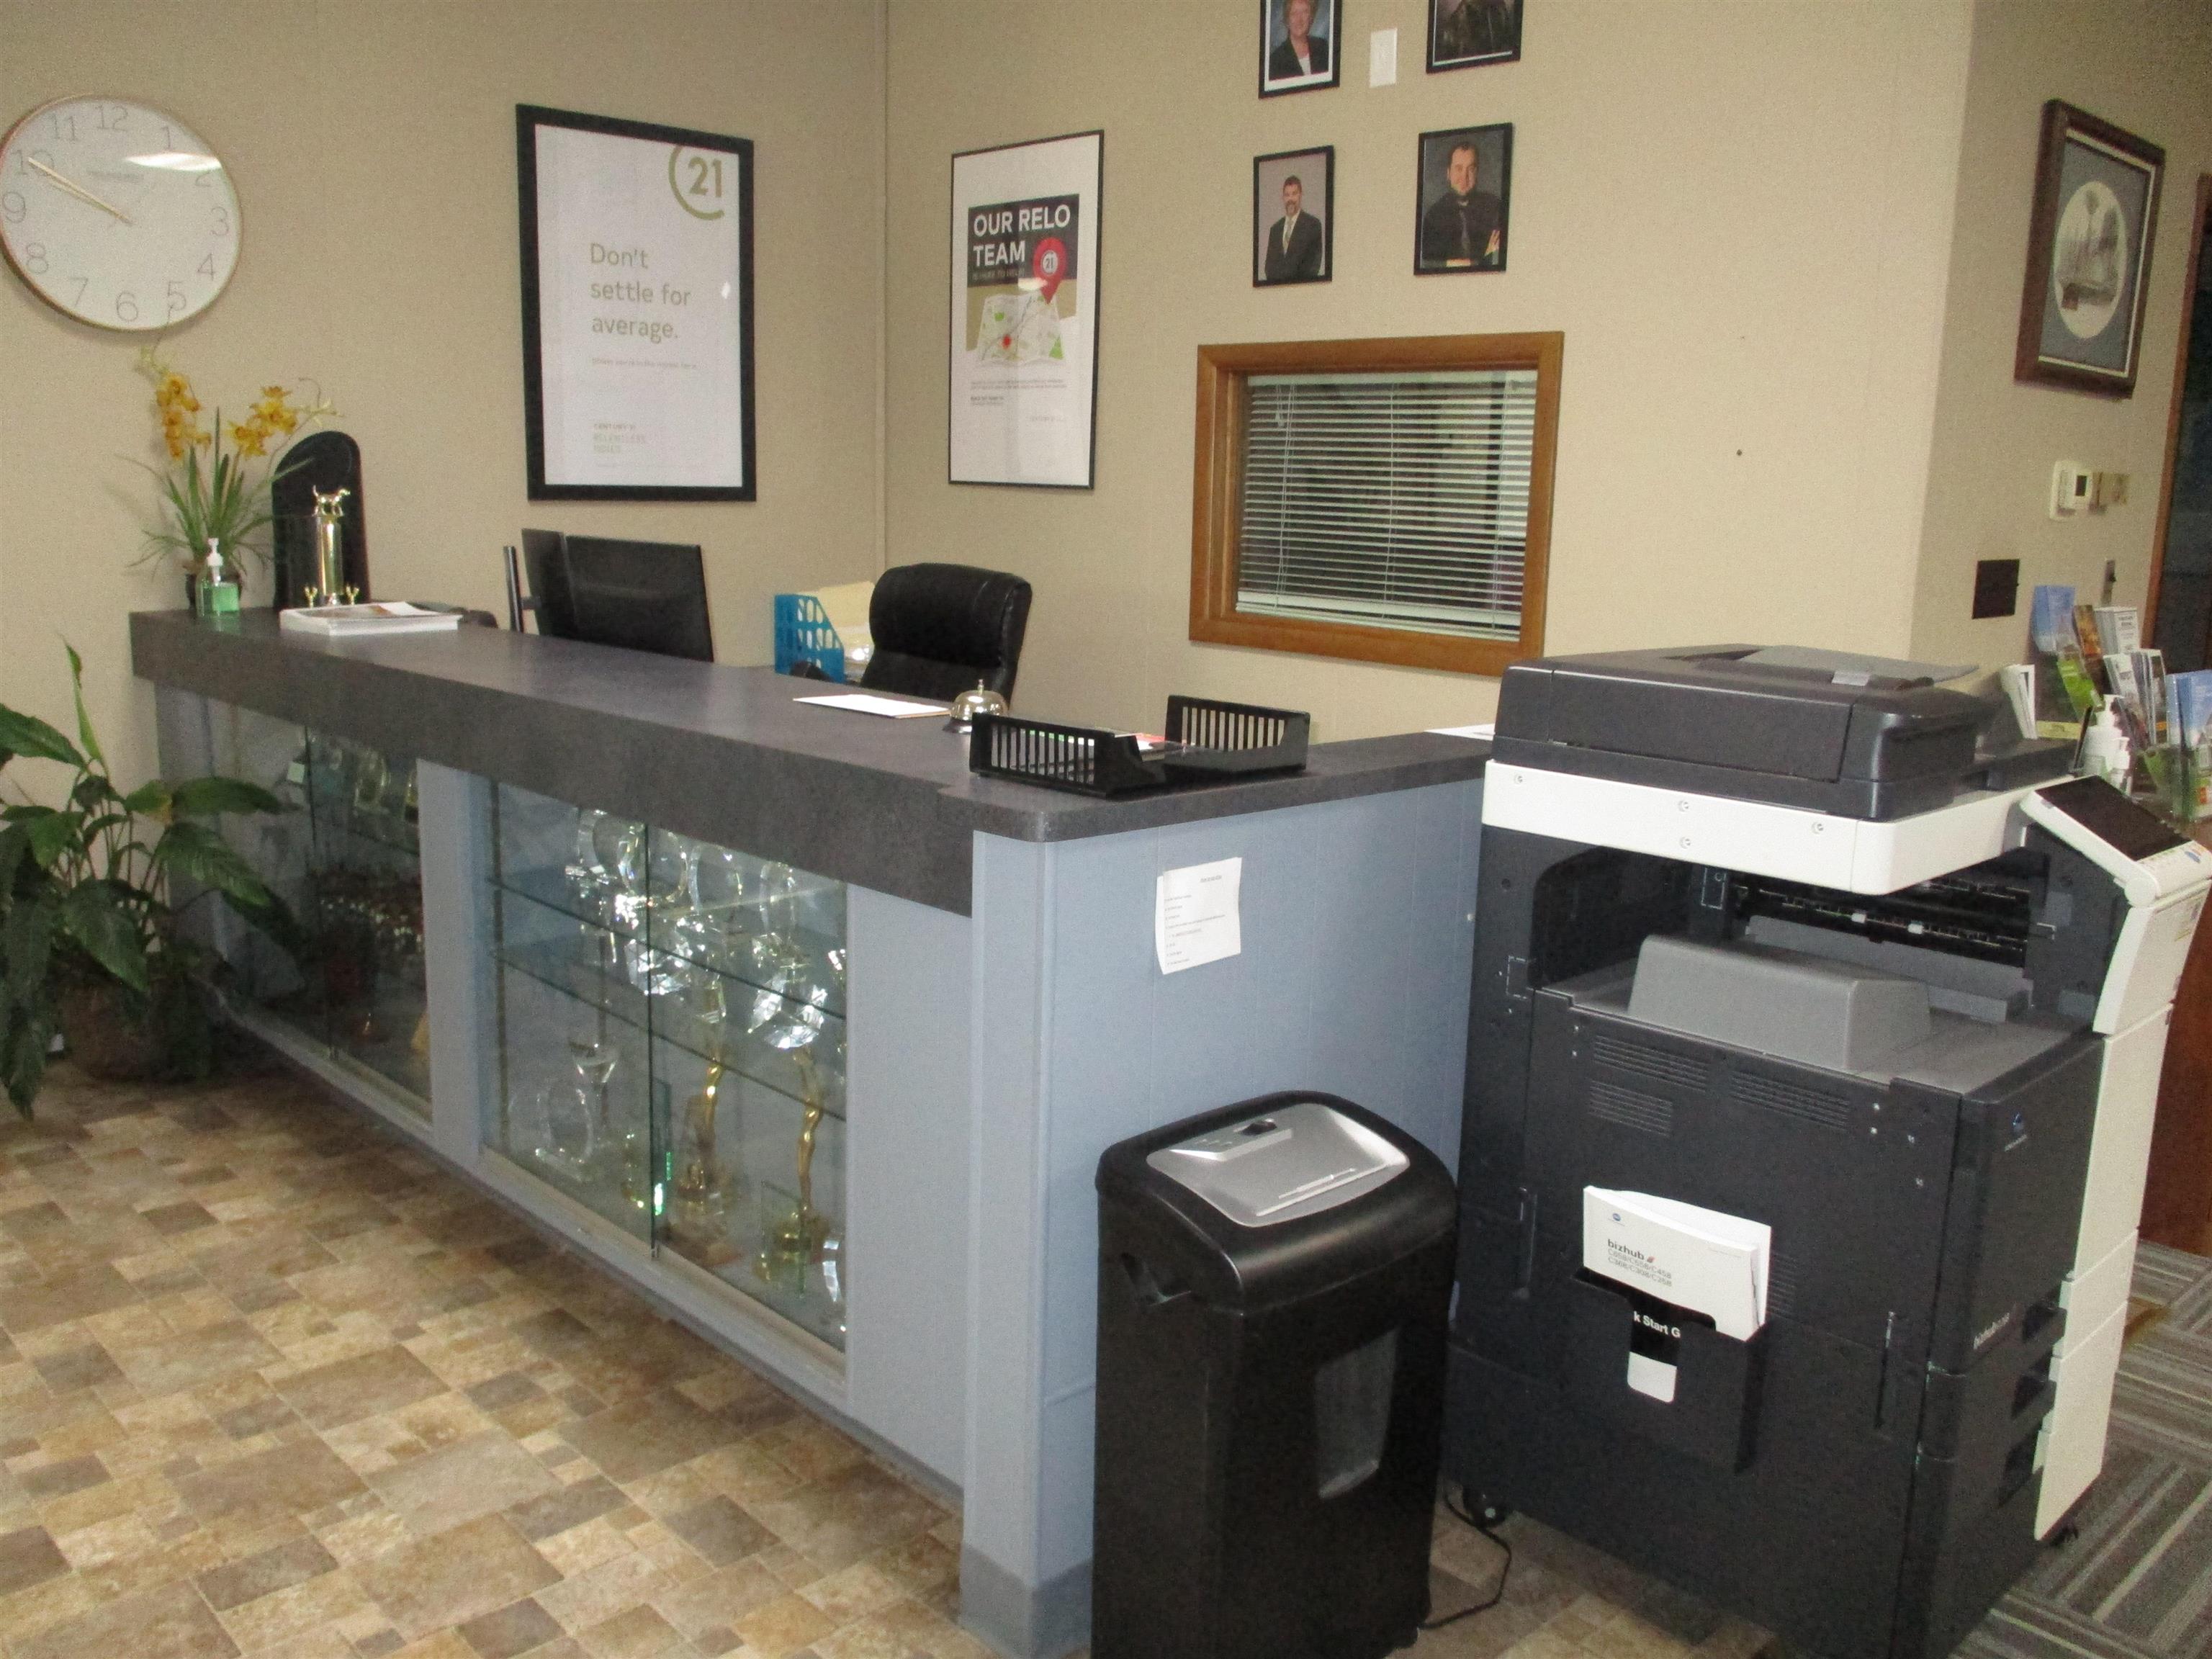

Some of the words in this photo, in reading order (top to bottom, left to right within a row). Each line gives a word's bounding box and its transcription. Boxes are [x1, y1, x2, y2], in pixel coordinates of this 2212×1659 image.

[48, 112, 78, 142] 11
[95, 105, 129, 131] 12
[161, 126, 172, 149] 1
[14, 149, 55, 178] 10
[688, 156, 722, 198] 21
[1, 191, 27, 224] 9
[210, 206, 230, 237] 3
[974, 211, 1013, 237] OUR
[1018, 204, 1071, 232] RELO
[26, 242, 49, 274] 8
[197, 253, 216, 282] 4
[590, 242, 649, 269] Don't
[973, 240, 1025, 267] TEAM
[69, 276, 89, 308] 7
[115, 290, 139, 322] 6
[166, 280, 187, 312] 5
[590, 280, 654, 303] settle
[662, 282, 691, 306] for
[592, 317, 679, 344] average.
[1607, 1238, 1645, 1260] bizhub
[1642, 1314, 1669, 1336] Start
